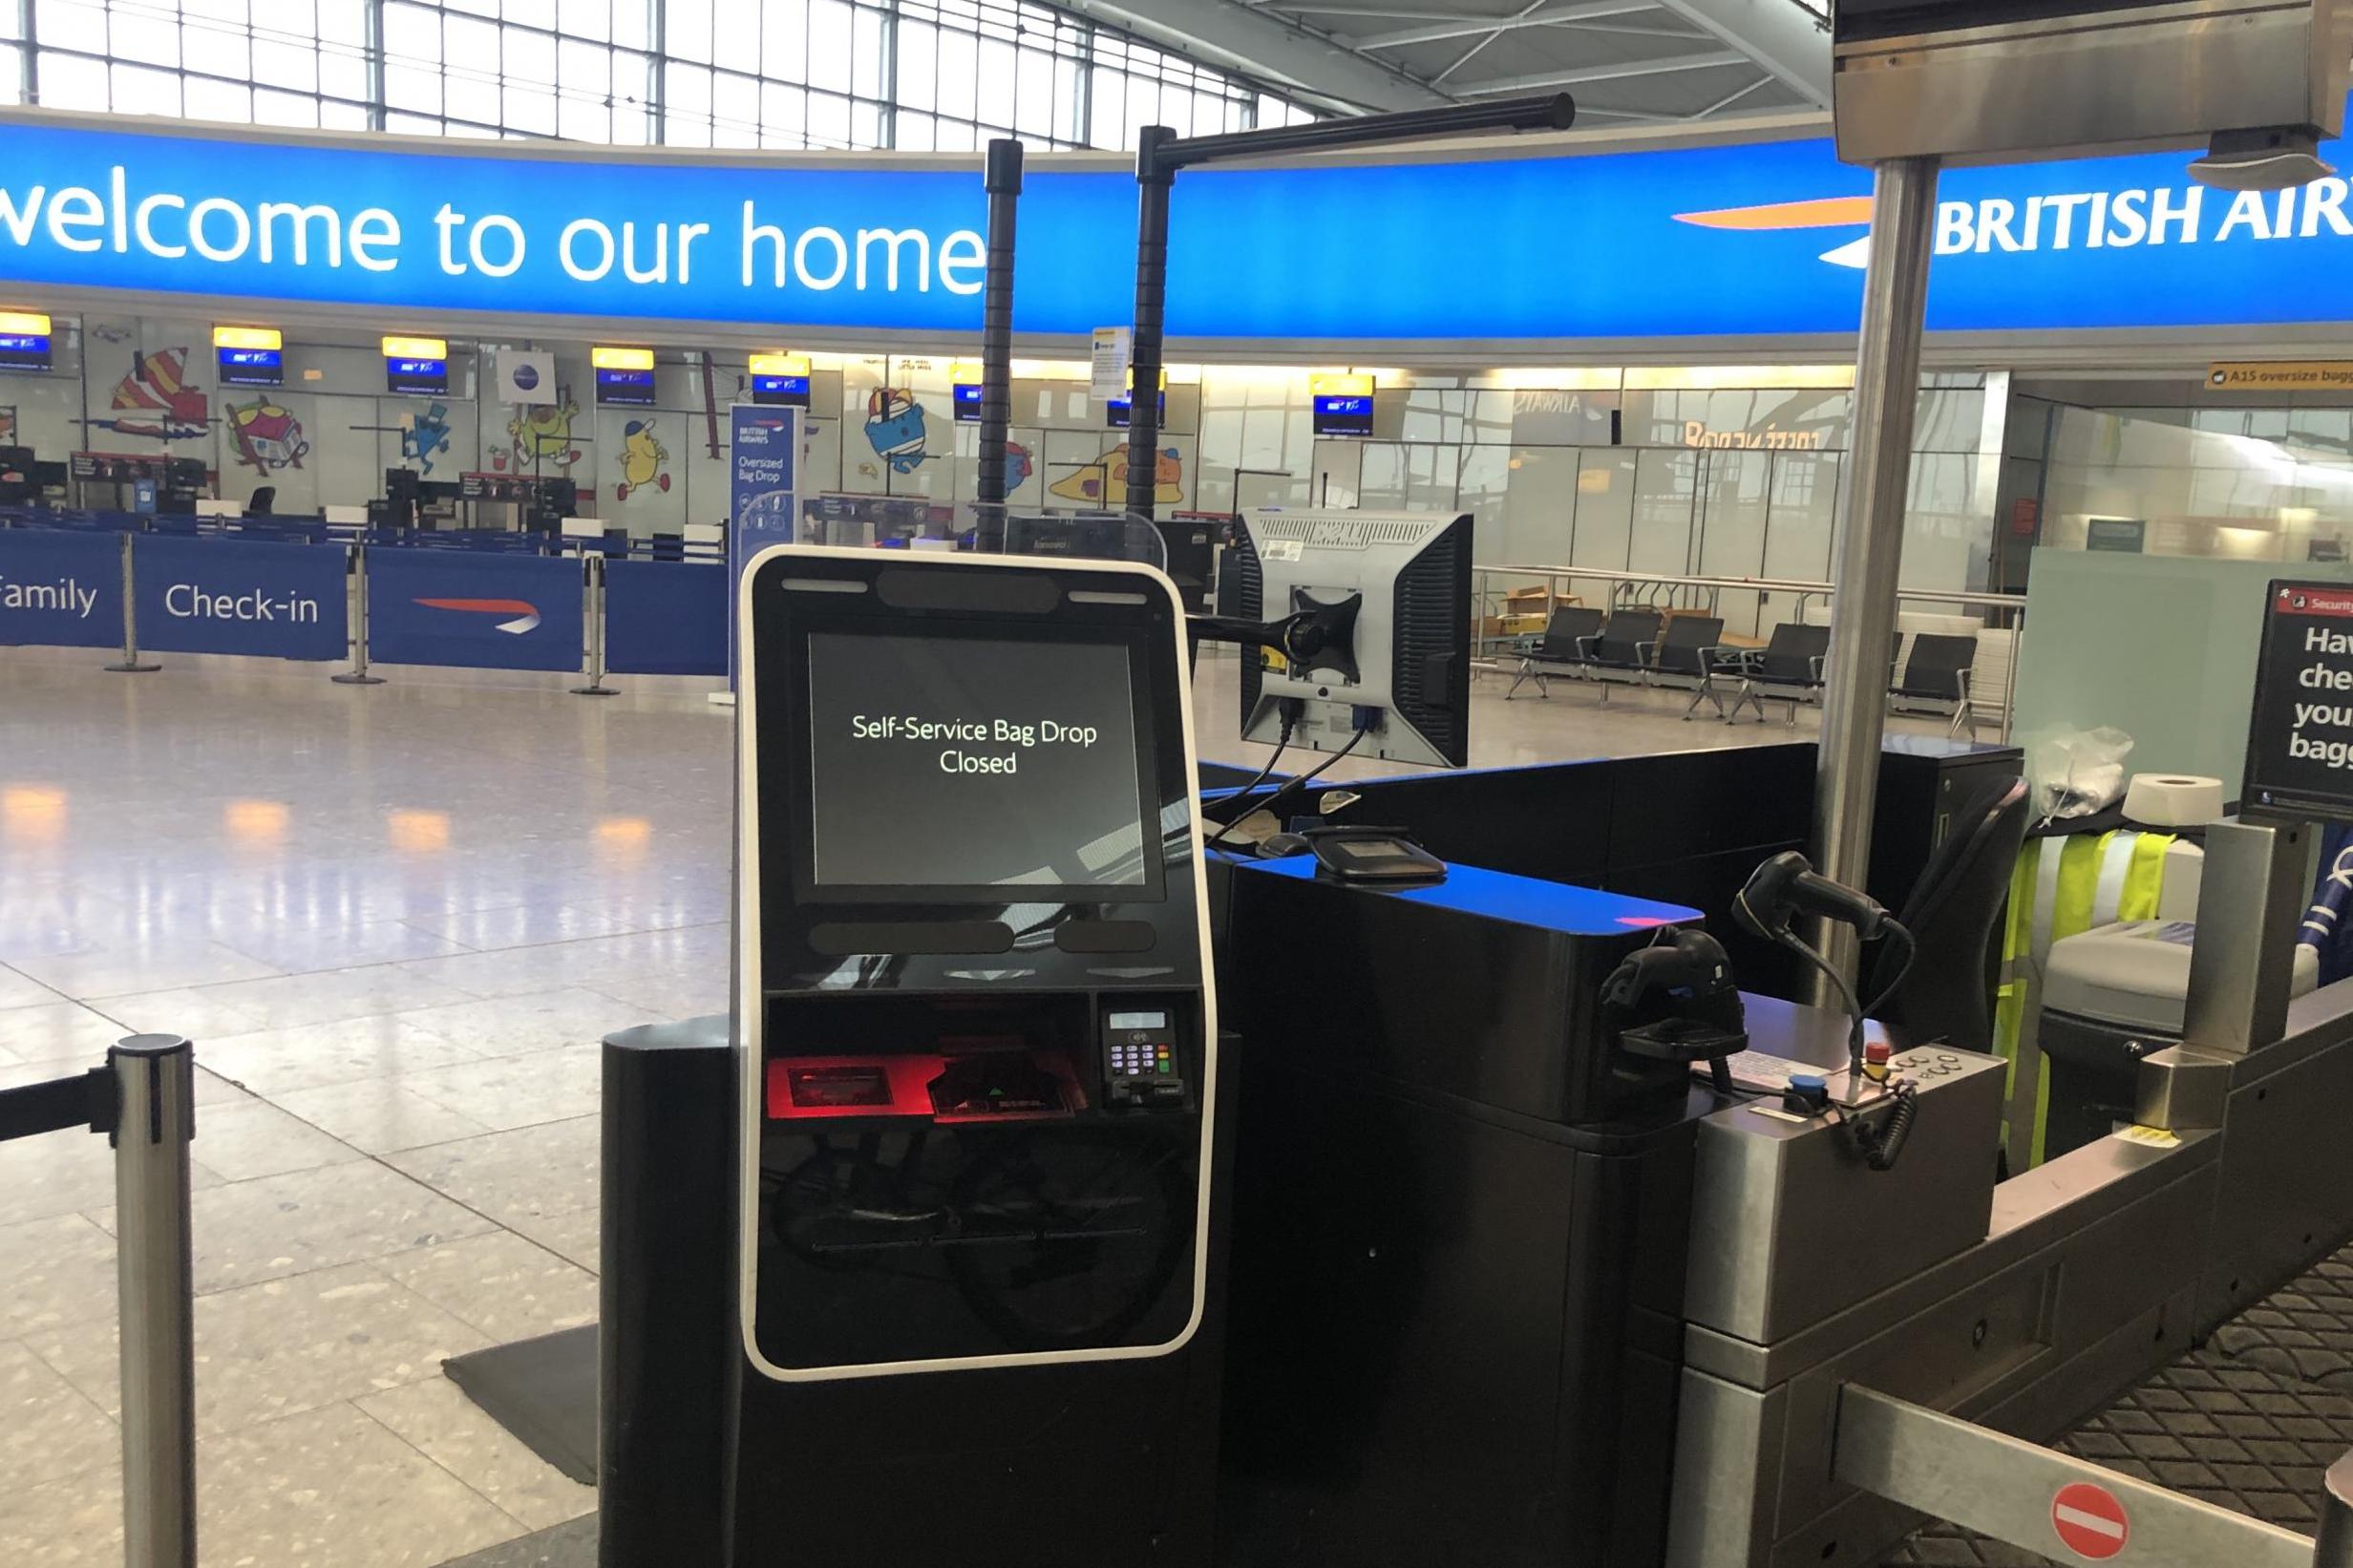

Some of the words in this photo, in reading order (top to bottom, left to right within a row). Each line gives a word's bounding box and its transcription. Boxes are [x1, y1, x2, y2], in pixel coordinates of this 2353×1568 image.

[1934, 186, 2204, 254] BRITISH
[2214, 177, 2353, 242] AIR
[434, 203, 526, 277] to
[559, 219, 710, 284] our
[742, 200, 986, 295] home
[2230, 371, 2257, 381] A15
[2259, 370, 2318, 382] oversize
[738, 456, 783, 469] Oversized
[738, 470, 755, 483] Bag
[755, 471, 780, 483] Drop
[0, 575, 97, 619] amily
[165, 584, 318, 623] Check-in
[853, 715, 987, 741] Self-Service
[994, 719, 1036, 748] Bag
[1041, 720, 1098, 750] Drop
[940, 750, 1017, 774] Closed
